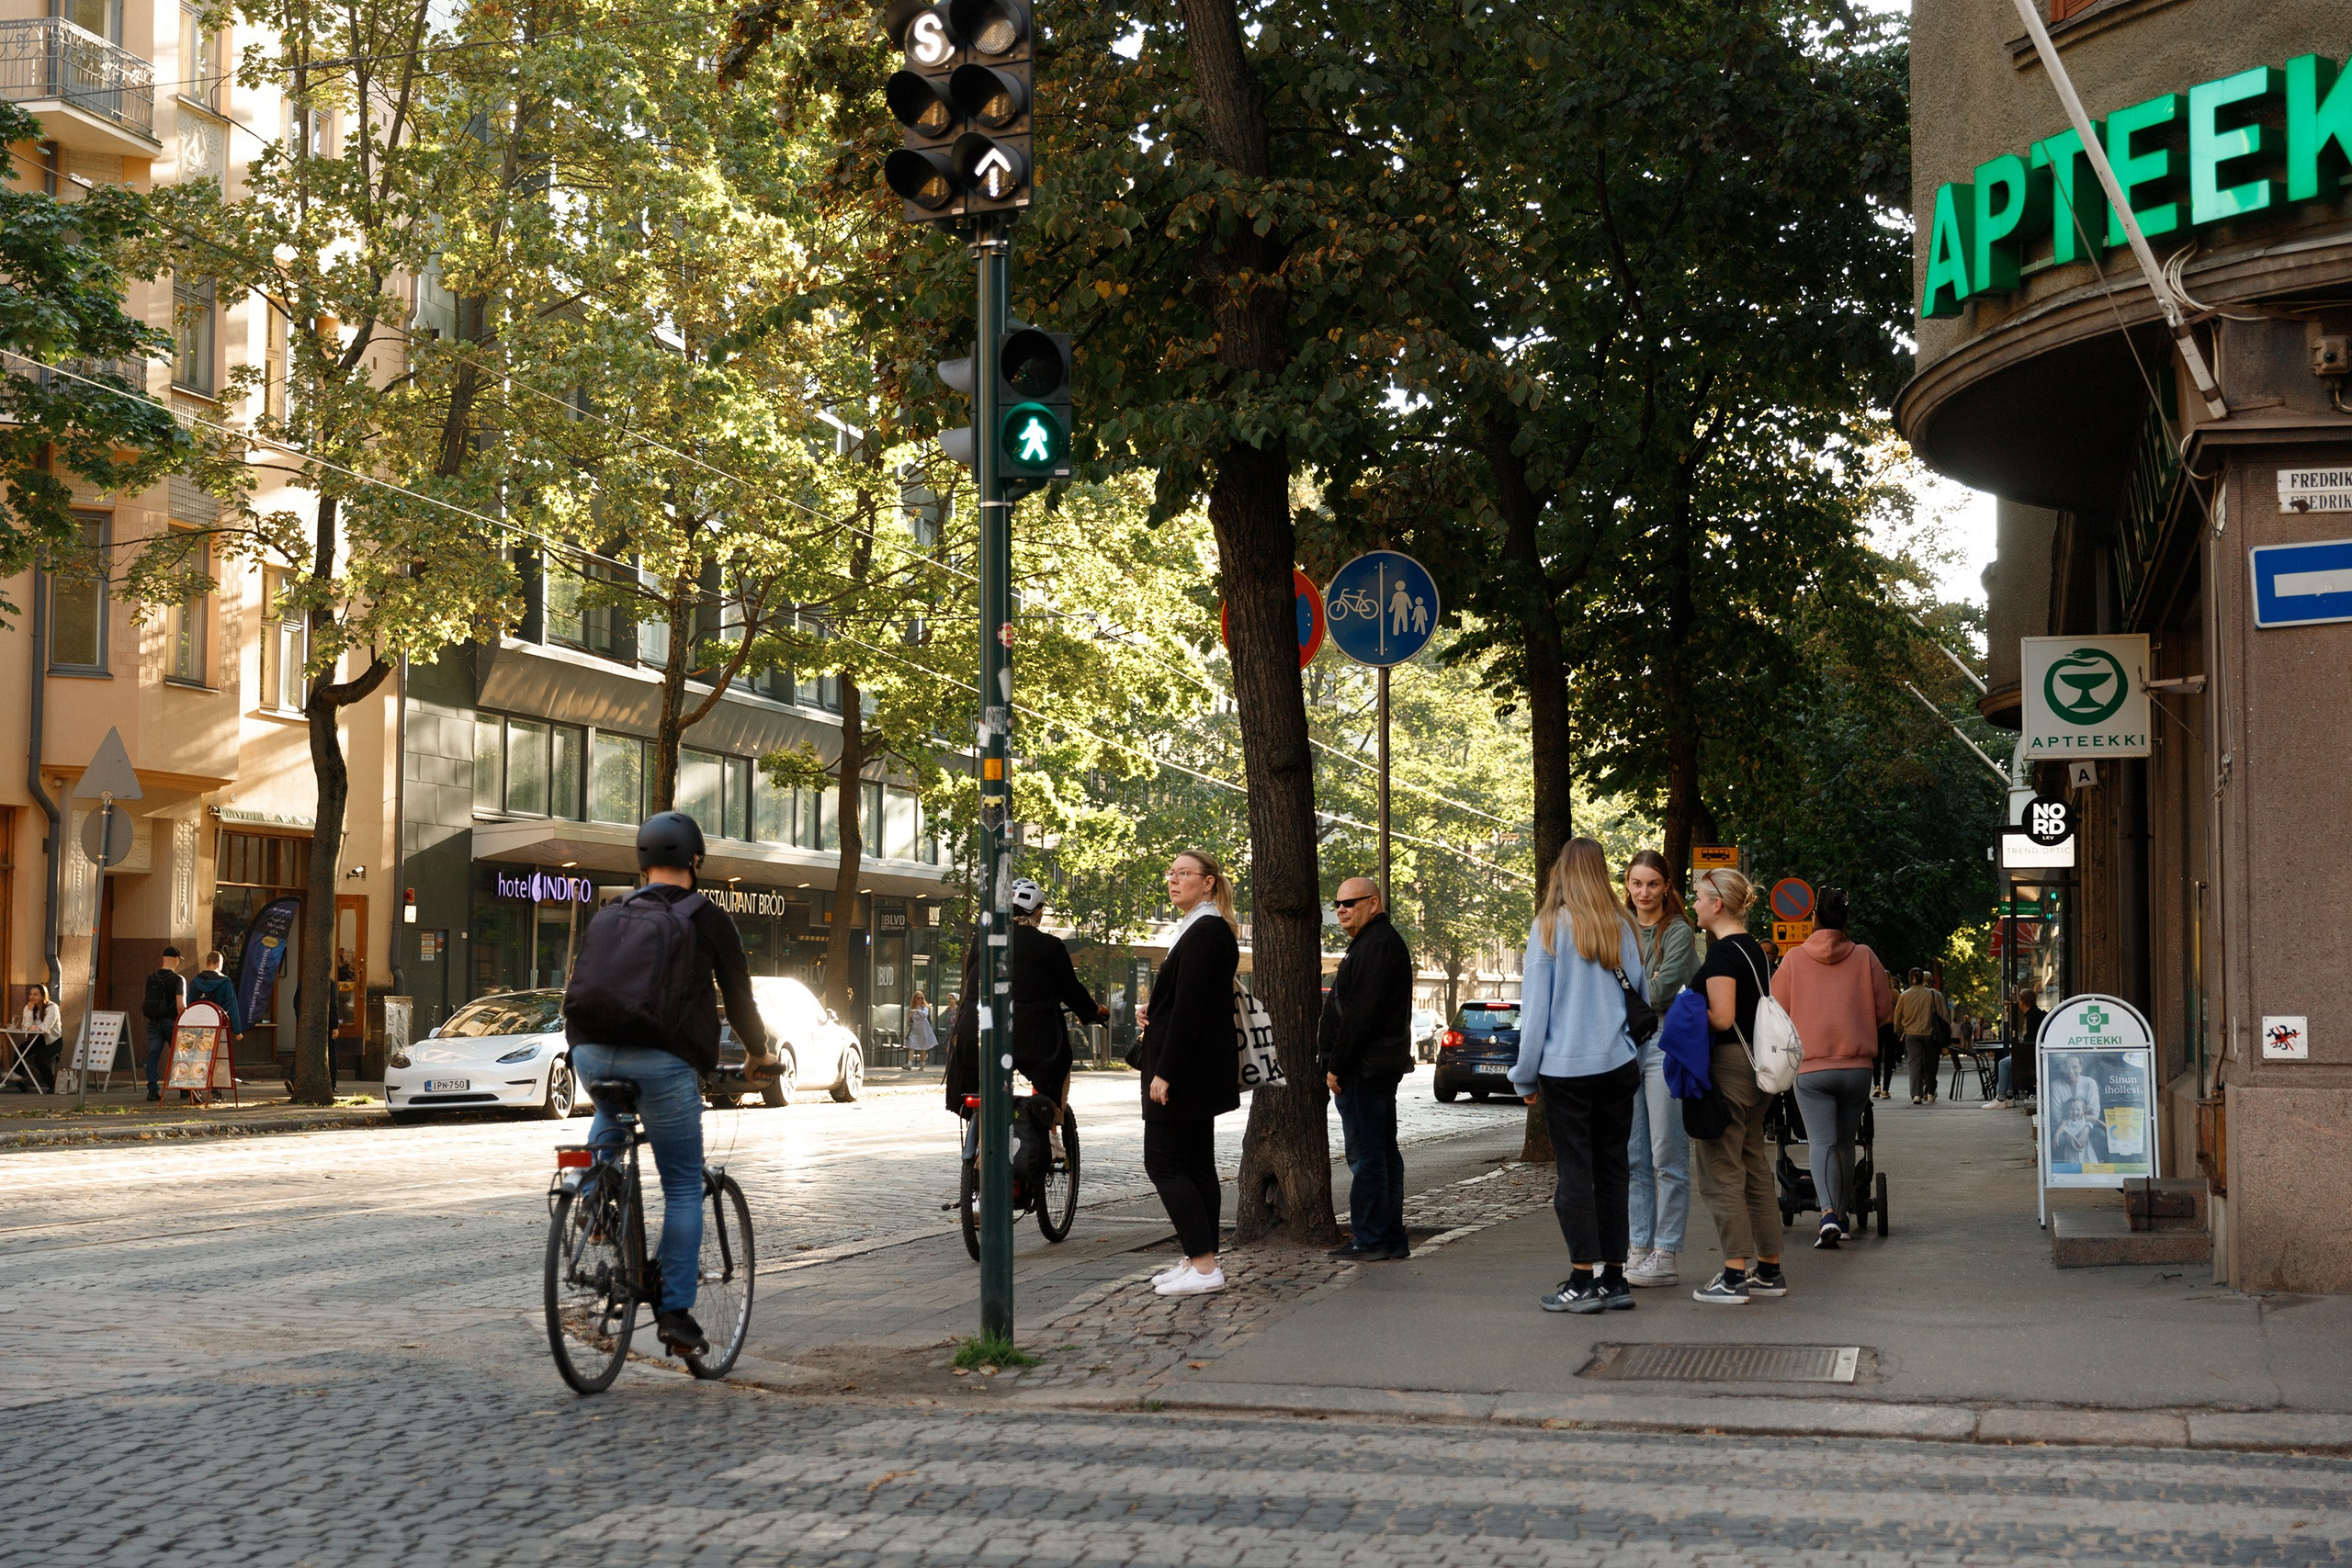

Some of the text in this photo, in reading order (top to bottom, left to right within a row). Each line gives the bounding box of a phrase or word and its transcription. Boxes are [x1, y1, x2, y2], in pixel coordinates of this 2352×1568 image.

[914, 13, 942, 62] S
[2290, 471, 2352, 488] FREDRIK
[2290, 494, 2352, 510] FEDRIK
[2031, 735, 2145, 748] APTEEKKI
[2078, 769, 2090, 782] A
[2033, 803, 2065, 819] NO
[2033, 818, 2065, 835] RD
[2041, 846, 2071, 854] OPTIC
[499, 872, 531, 898] hotel
[759, 889, 785, 916] BRÖD
[884, 914, 905, 926] BLVD
[879, 966, 894, 987] BLVD
[2068, 1035, 2122, 1045] APTEEKKI
[1771, 1045, 1777, 1054] W
[434, 1080, 465, 1089] IPN-750
[2109, 1075, 2137, 1084] Sinun
[2104, 1085, 2143, 1094] ihollesi.
